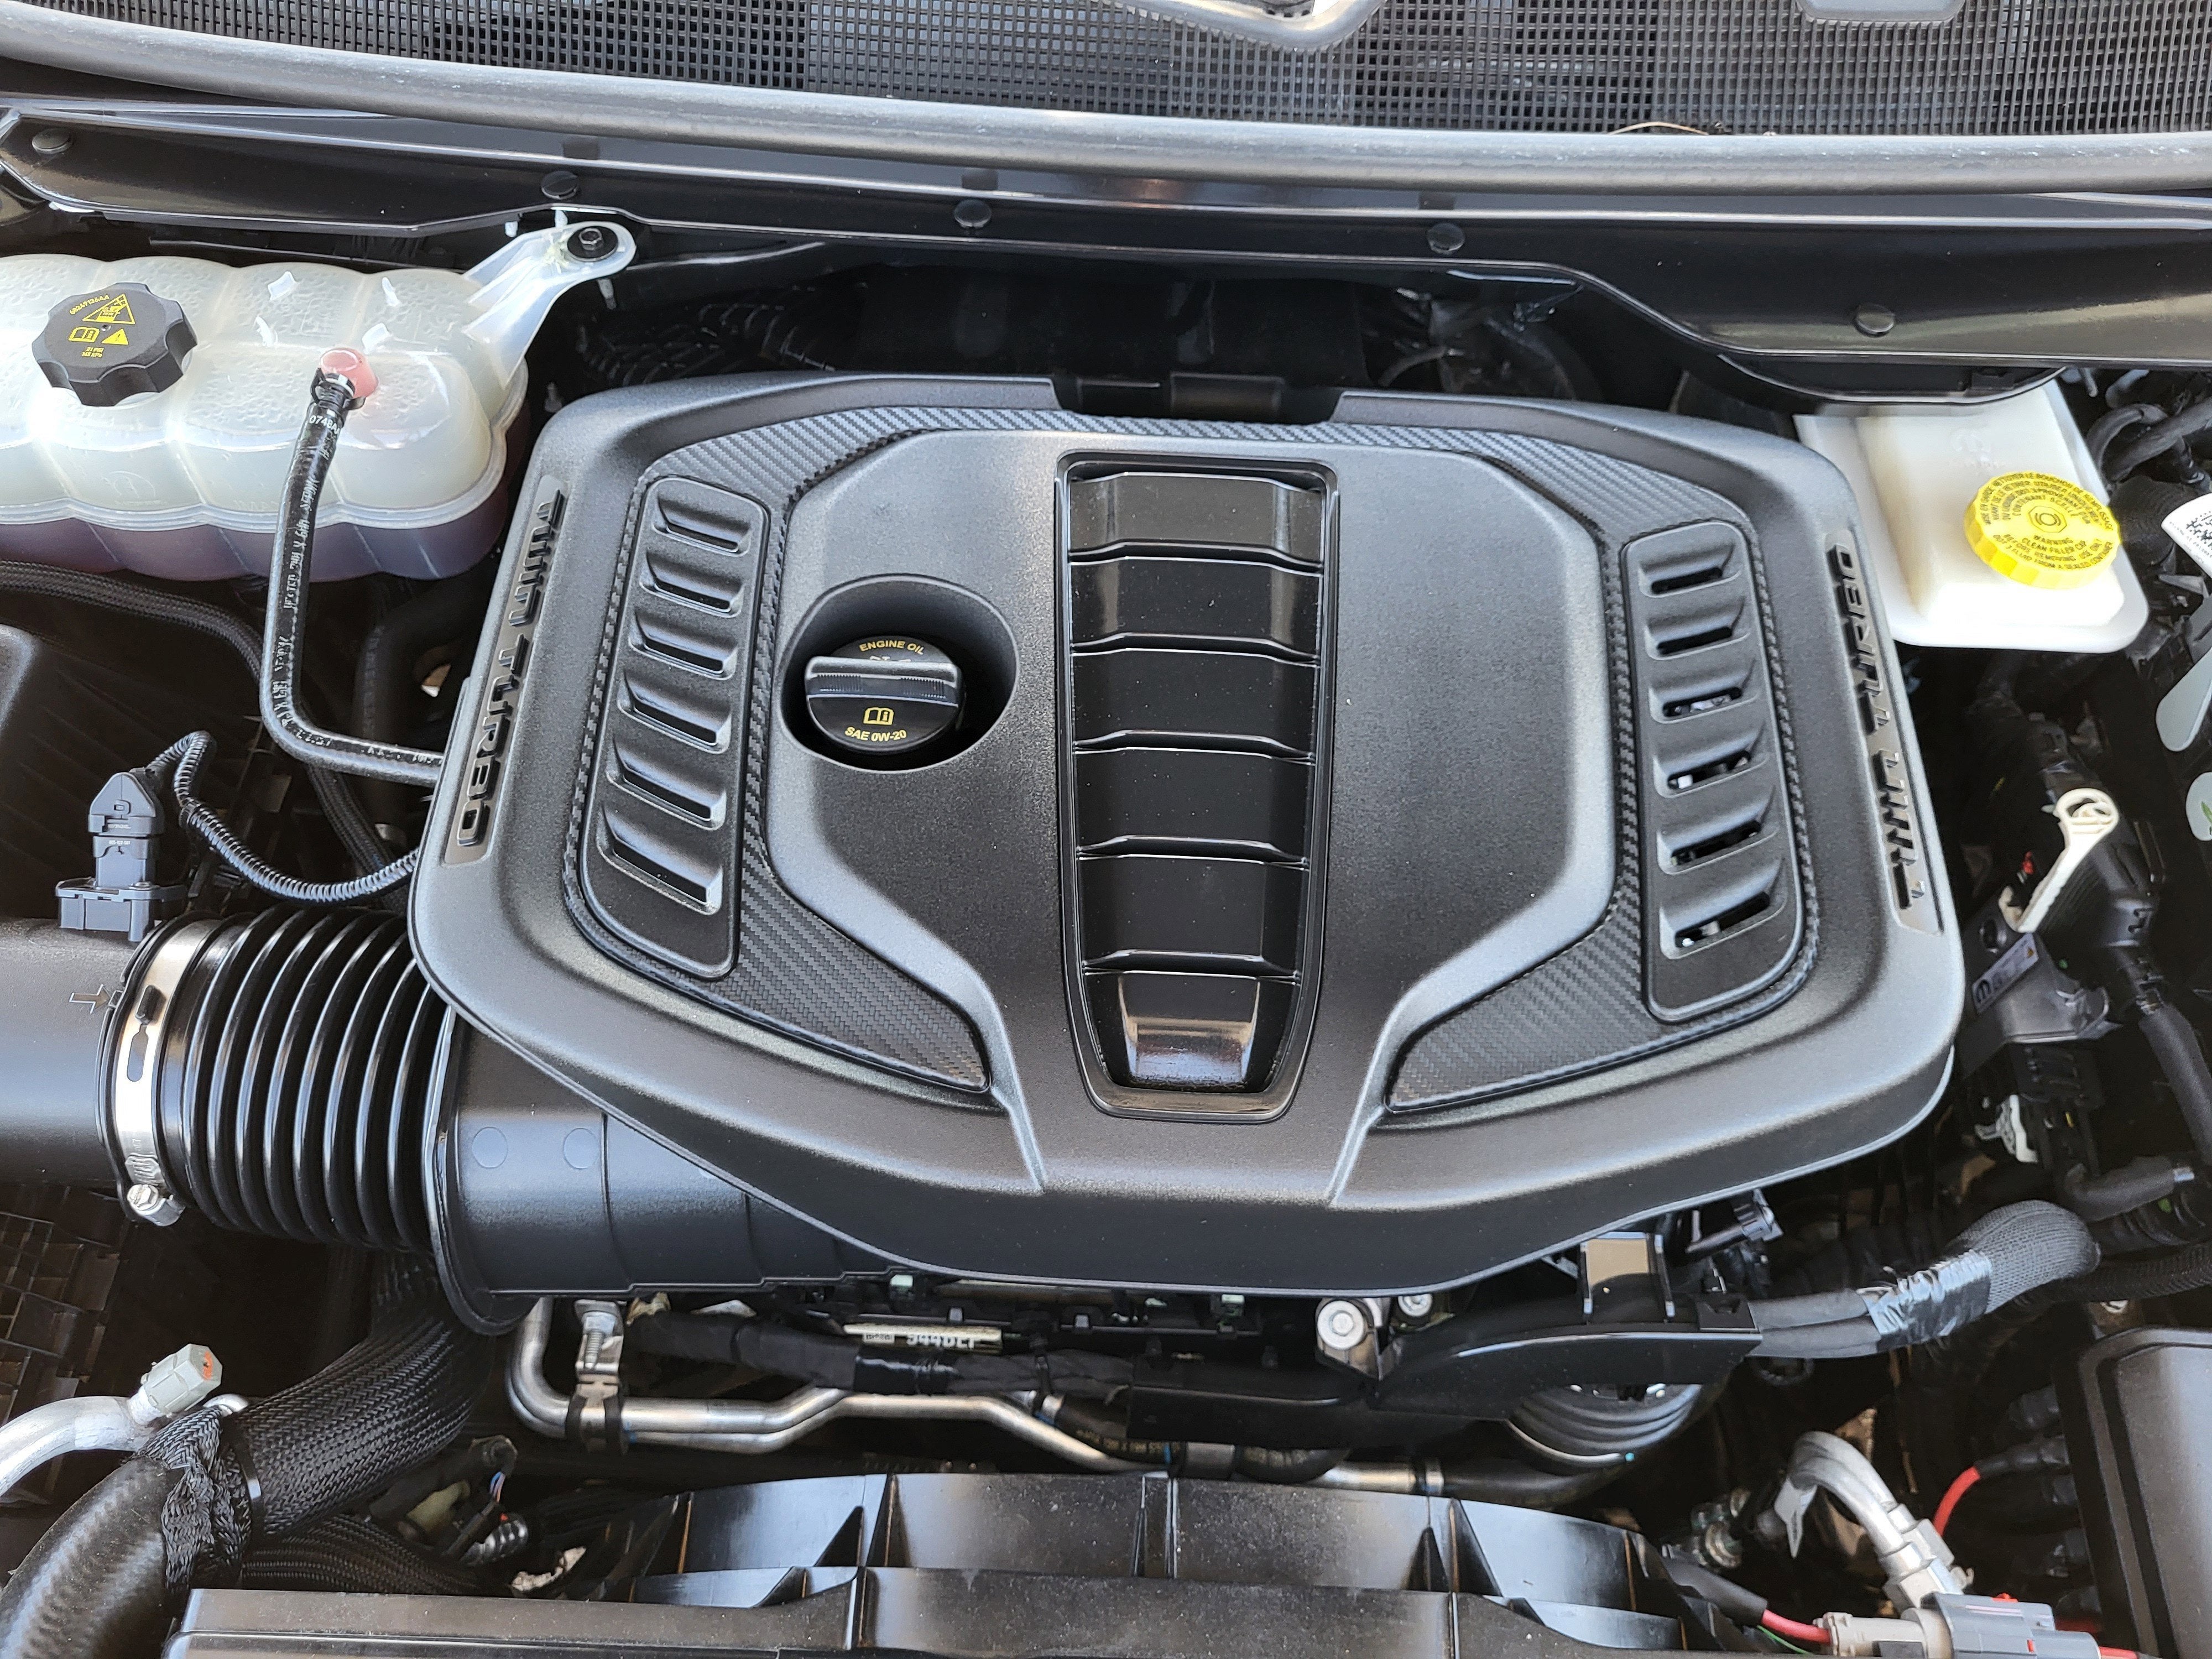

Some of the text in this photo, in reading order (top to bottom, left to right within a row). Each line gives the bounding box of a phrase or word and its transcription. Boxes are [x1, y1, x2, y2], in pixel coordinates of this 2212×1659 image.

[456, 488, 562, 847] TWIN TURBO
[859, 640, 925, 655] ENGINE OIL
[1826, 543, 1890, 736] TURBO
[844, 726, 907, 742] SAE 0W-20
